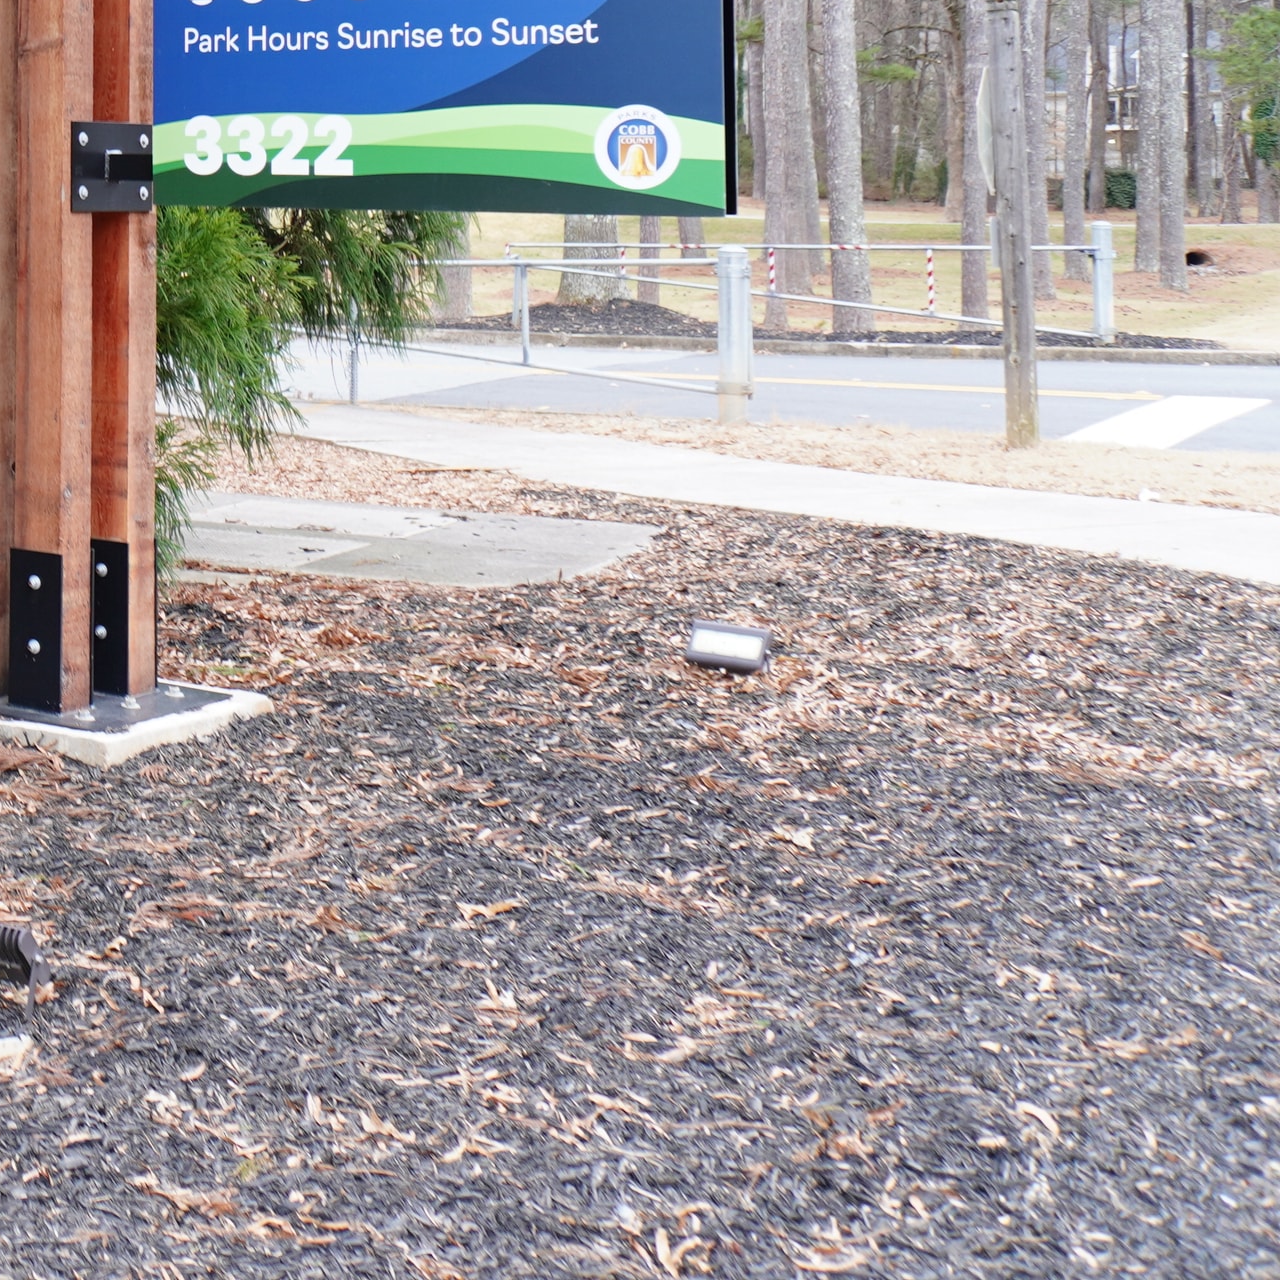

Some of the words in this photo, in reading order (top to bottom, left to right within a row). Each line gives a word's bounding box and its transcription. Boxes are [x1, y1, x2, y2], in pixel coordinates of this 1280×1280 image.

[183, 27, 240, 54] Park
[247, 24, 329, 52] Hours
[336, 22, 443, 50] Sunrise
[450, 22, 482, 47] to
[491, 17, 599, 46] Sunset
[183, 114, 354, 176] 3322
[618, 125, 655, 135] COBB
